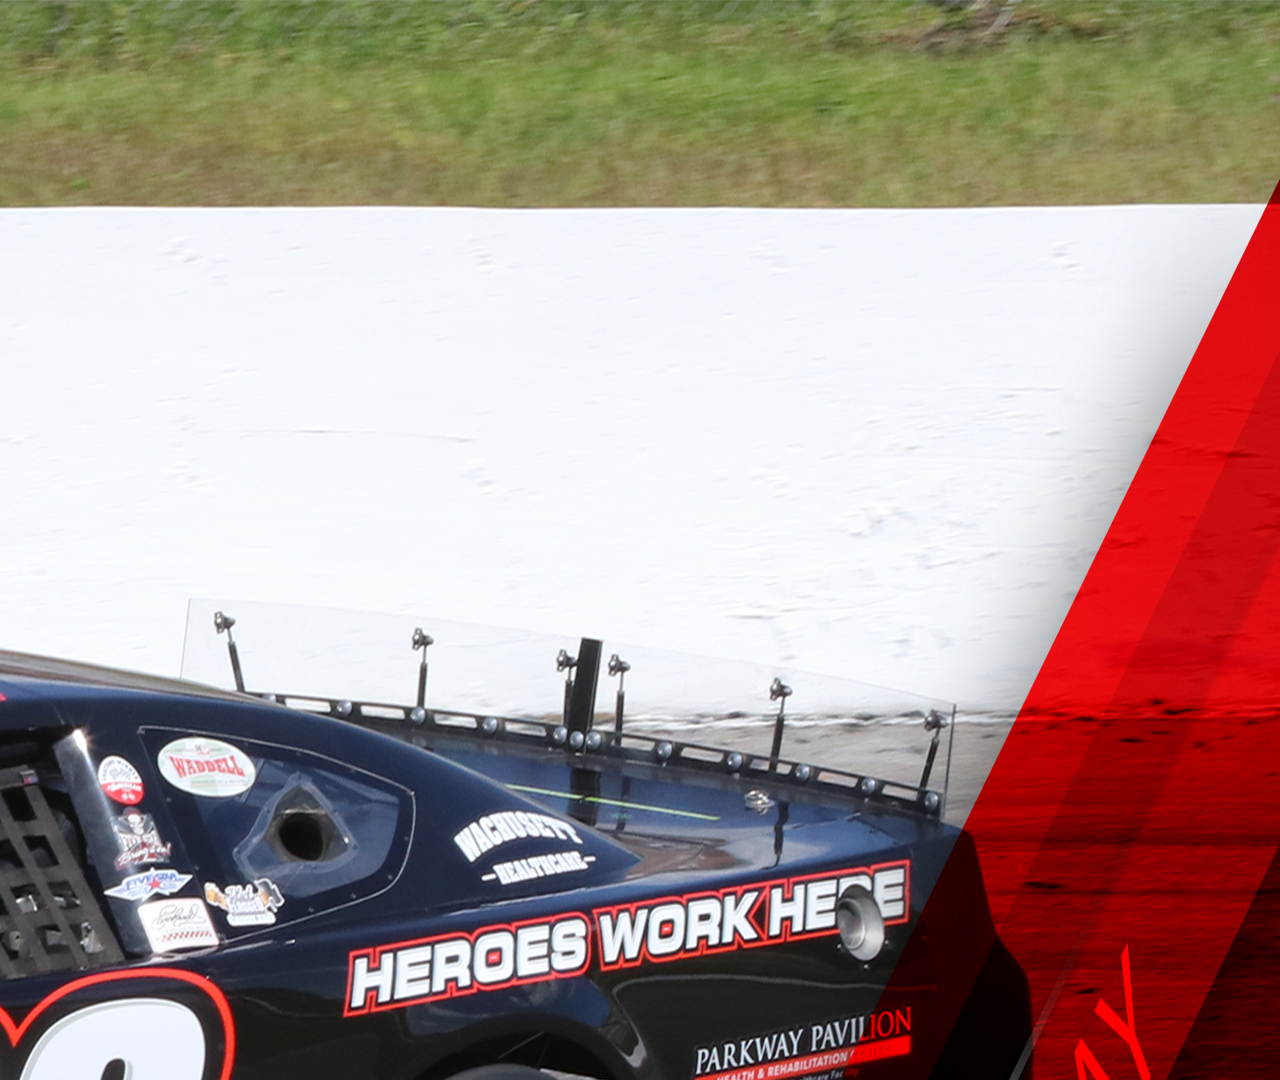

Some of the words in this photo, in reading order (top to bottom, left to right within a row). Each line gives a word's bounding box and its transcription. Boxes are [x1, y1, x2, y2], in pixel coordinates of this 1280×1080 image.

[169, 755, 246, 778] WADDELL
[454, 811, 583, 862] WACHUSETT
[349, 918, 588, 1009] HEROES
[599, 888, 759, 963] WORK
[695, 1028, 804, 1075] PARKWAY
[811, 1006, 912, 1051] PAVILION
[757, 1067, 765, 1079] &
[767, 1052, 848, 1077] REHABILITATION
